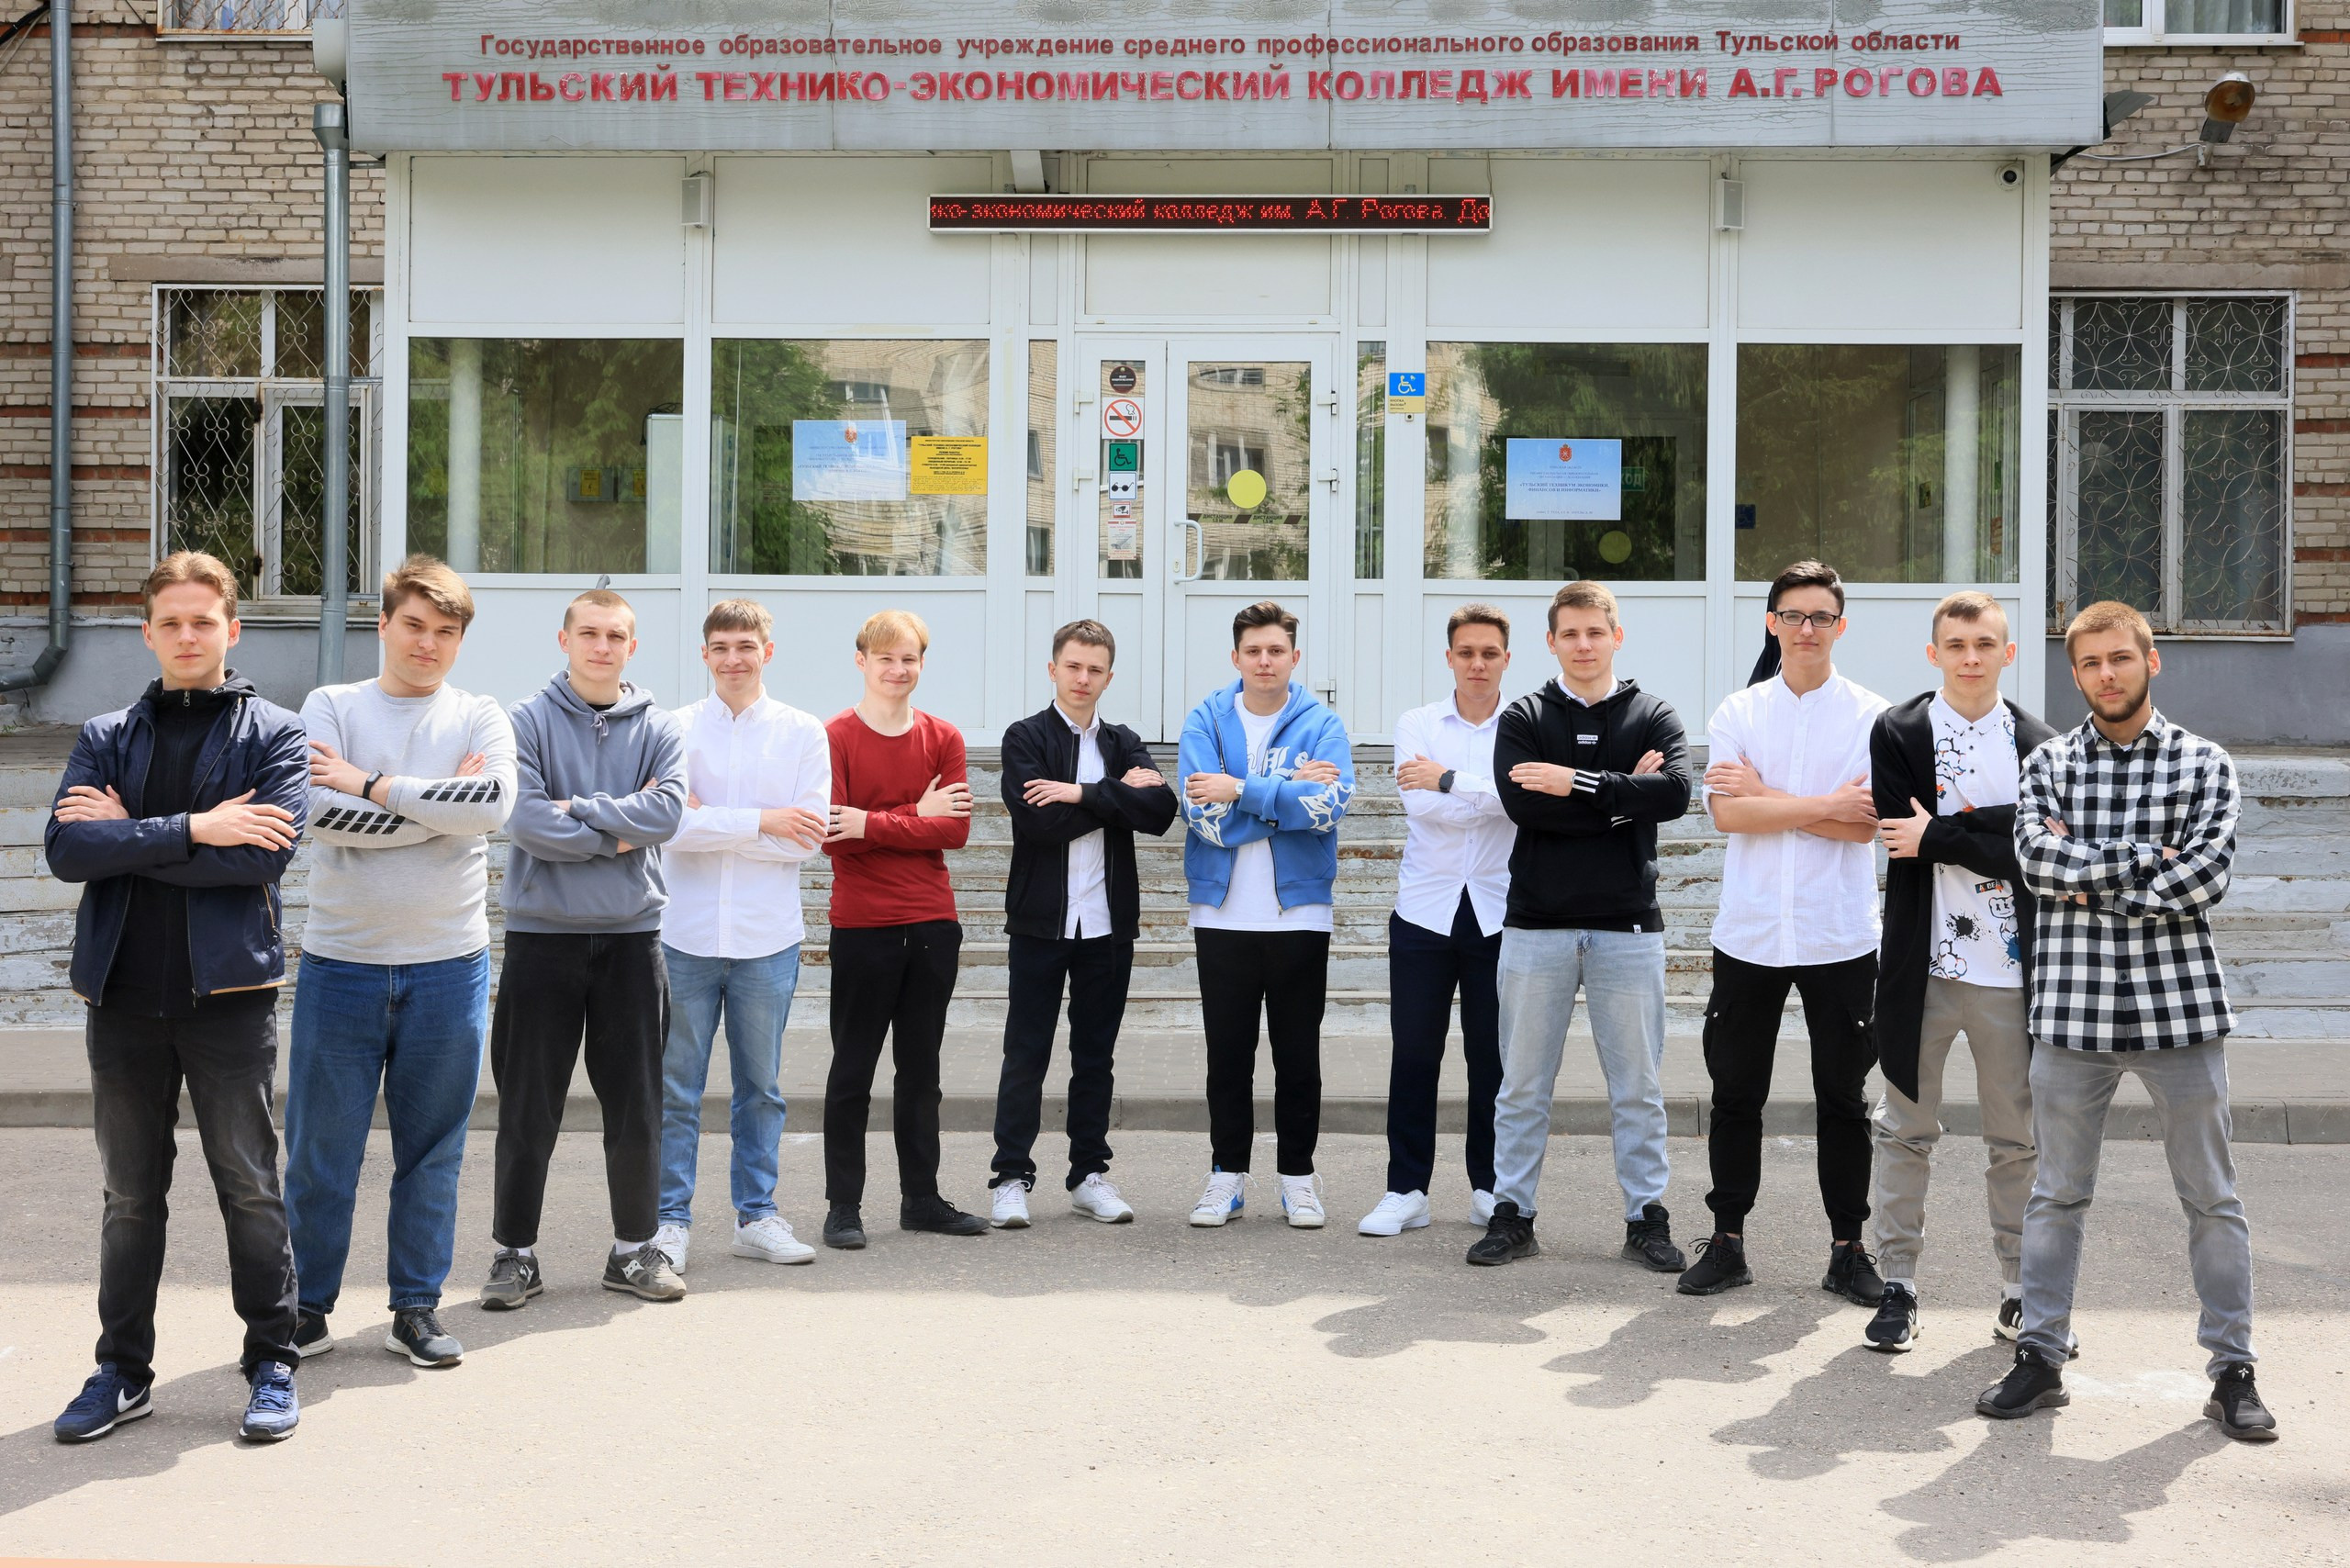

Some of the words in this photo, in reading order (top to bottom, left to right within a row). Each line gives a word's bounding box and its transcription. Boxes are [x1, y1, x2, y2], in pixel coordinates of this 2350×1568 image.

[480, 34, 705, 59] Государственное
[719, 34, 941, 59] образовательное
[957, 39, 1113, 59] учреждение
[1124, 38, 1246, 58] среднего
[1258, 33, 1523, 57] профессионального
[1532, 30, 1699, 55] образования
[1851, 30, 1960, 51] области
[442, 64, 677, 102] ТУЛЬСКИЙ
[695, 63, 1291, 102] ТЕХНИКО-ЭКОНОМИЧЕСКИЙ
[1307, 69, 1533, 104] КОЛЛЕДЖ
[1551, 68, 1707, 98] ИМЕНИ
[1153, 204, 1254, 223] колледж
[1259, 205, 1295, 219] им.
